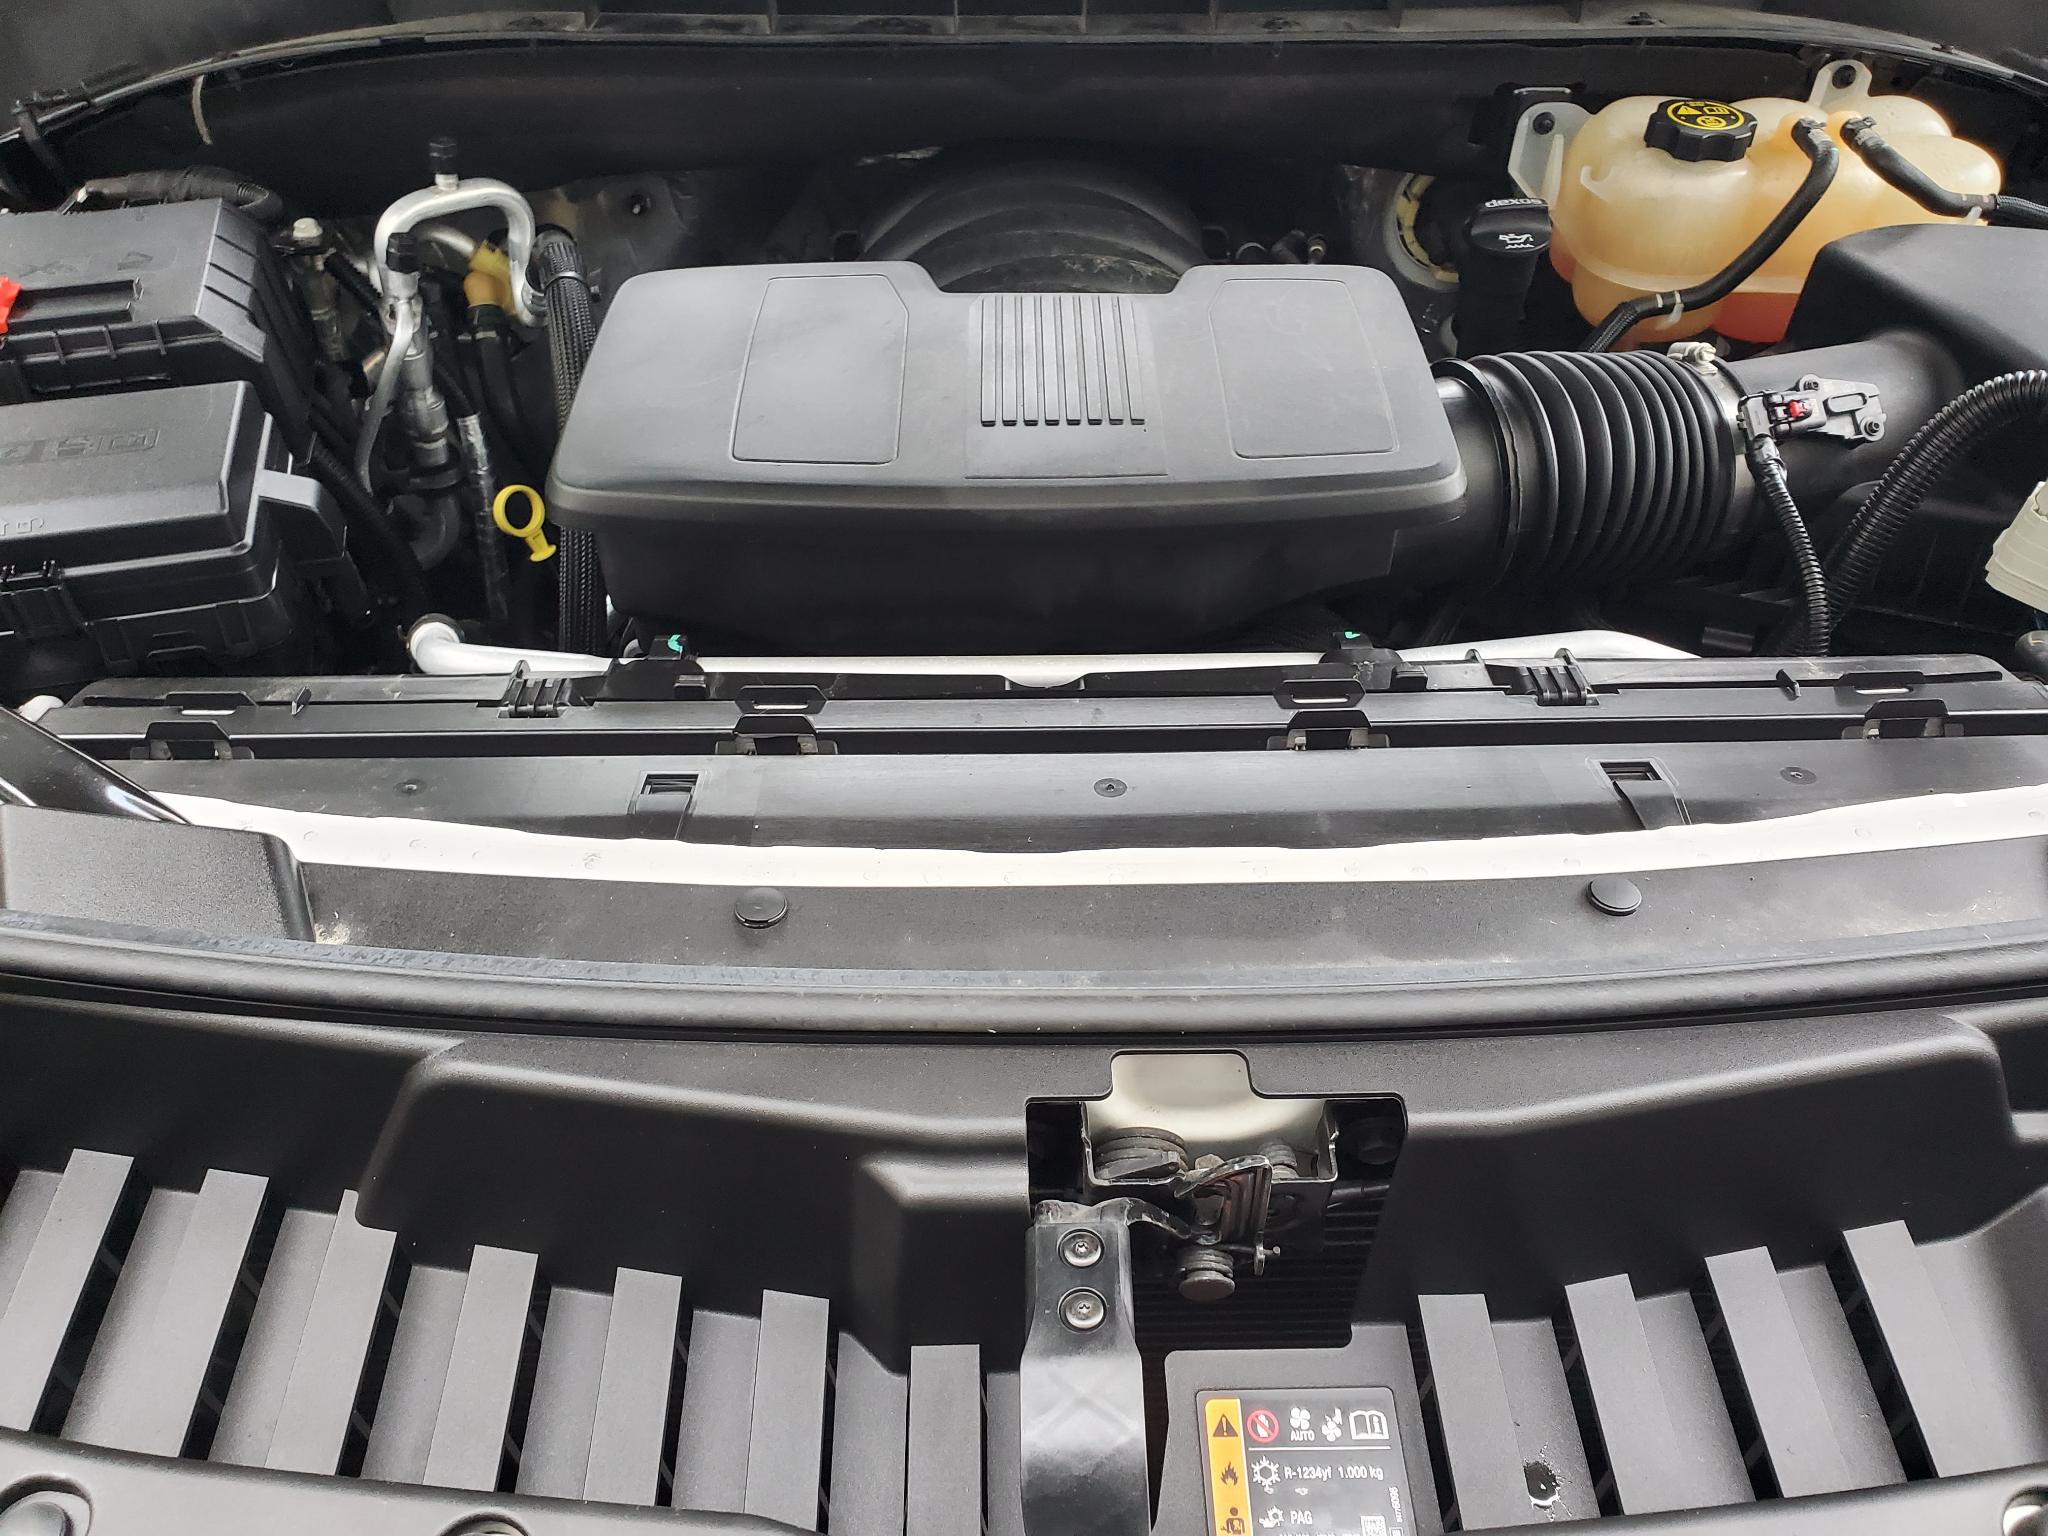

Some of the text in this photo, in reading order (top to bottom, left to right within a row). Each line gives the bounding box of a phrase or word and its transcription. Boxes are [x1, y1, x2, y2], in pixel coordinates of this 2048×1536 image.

[1485, 199, 1543, 208] dexos
[1290, 1429, 1315, 1441] AUTO
[1284, 1465, 1384, 1481] R-1234yf 1.000 kg
[1290, 1510, 1313, 1525] PAG
